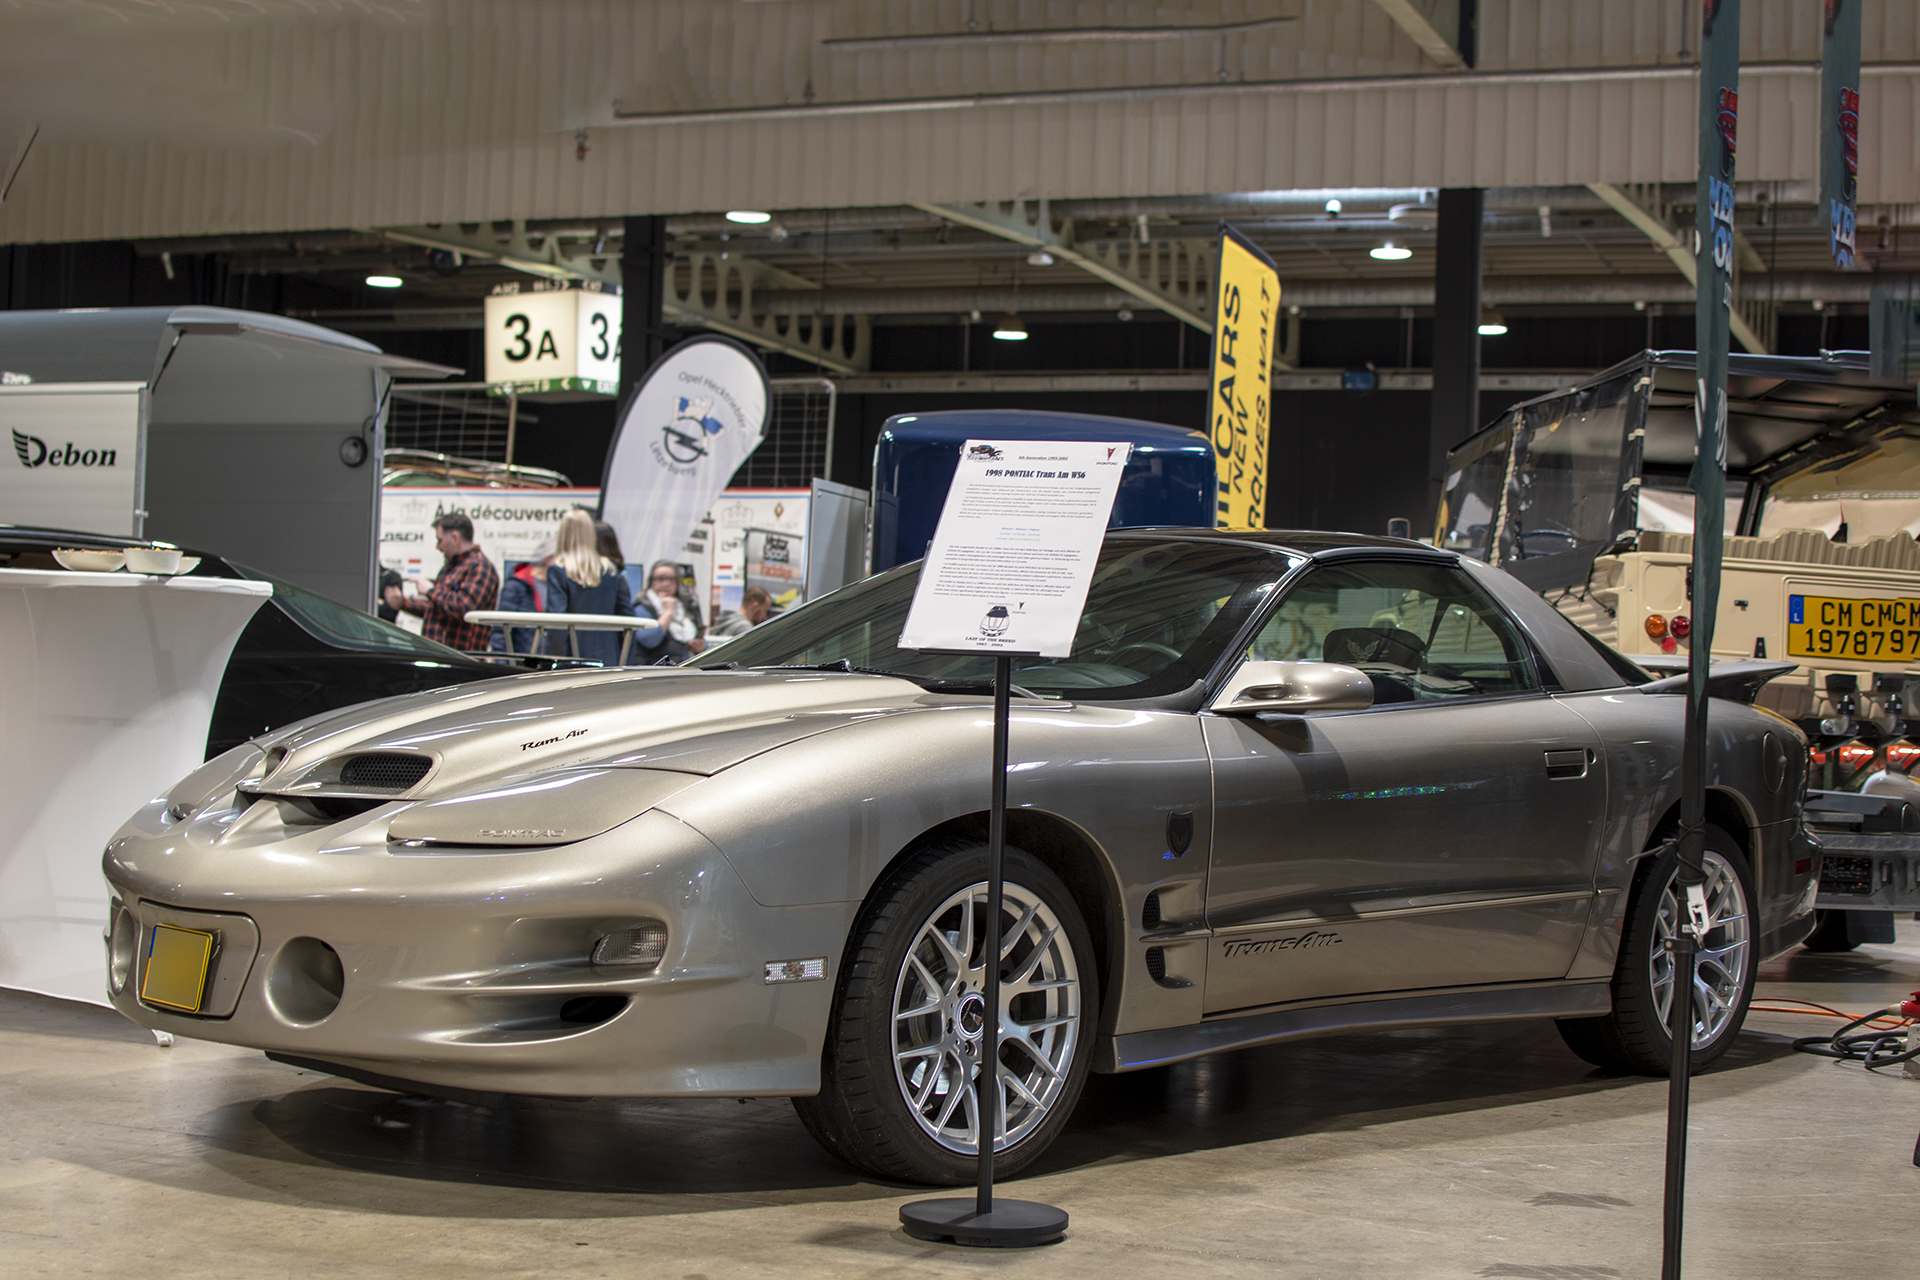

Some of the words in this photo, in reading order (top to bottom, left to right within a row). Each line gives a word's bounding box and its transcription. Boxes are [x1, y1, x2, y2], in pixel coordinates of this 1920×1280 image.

[504, 312, 559, 362] 3A
[678, 371, 703, 384] Opel
[12, 427, 117, 469] Debon
[1232, 396, 1249, 494] NEW
[985, 468, 1003, 477] 1998
[1004, 469, 1035, 478] PONTIAC
[1035, 470, 1056, 479] Trans
[1056, 471, 1069, 479] Am
[1071, 471, 1086, 479] WS6
[1793, 612, 1800, 622] L
[1821, 601, 1852, 627] CM
[519, 736, 564, 751] Ram
[565, 729, 589, 739] Air
